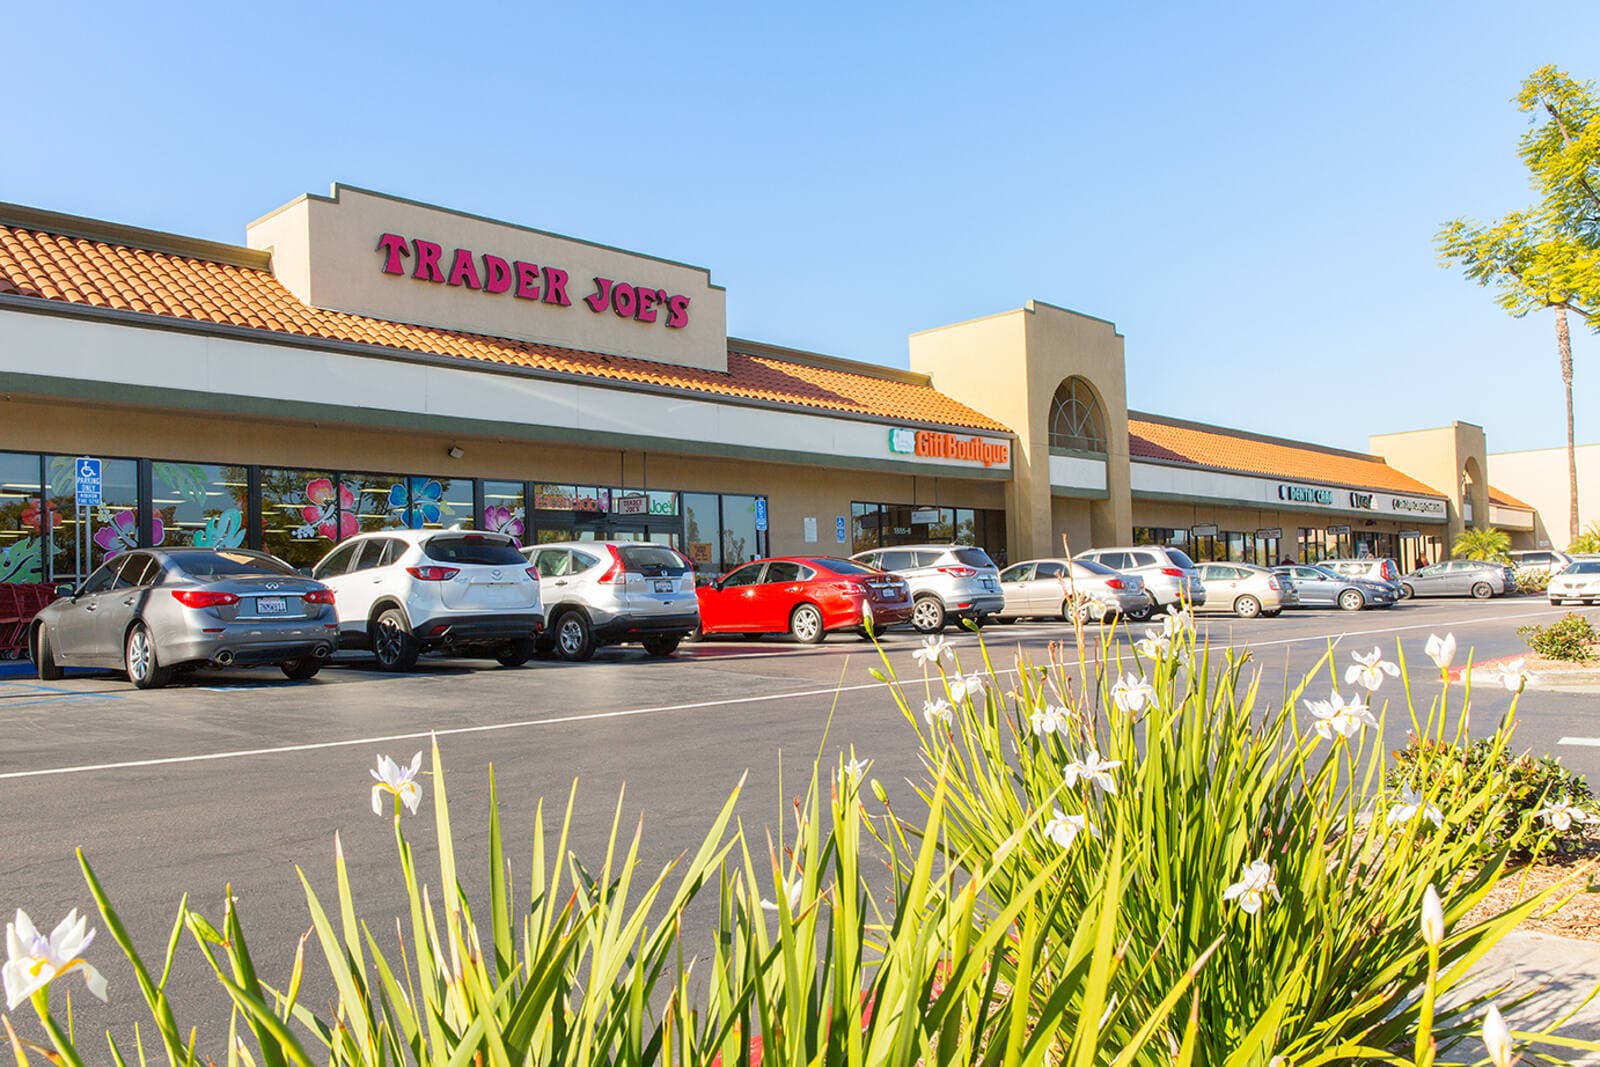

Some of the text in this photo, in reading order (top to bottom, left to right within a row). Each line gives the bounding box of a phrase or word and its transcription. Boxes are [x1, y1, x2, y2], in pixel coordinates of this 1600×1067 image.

[376, 232, 690, 328] TRADER JOE'S
[916, 431, 1008, 467] Gift Boutique
[623, 499, 642, 507] TRADER
